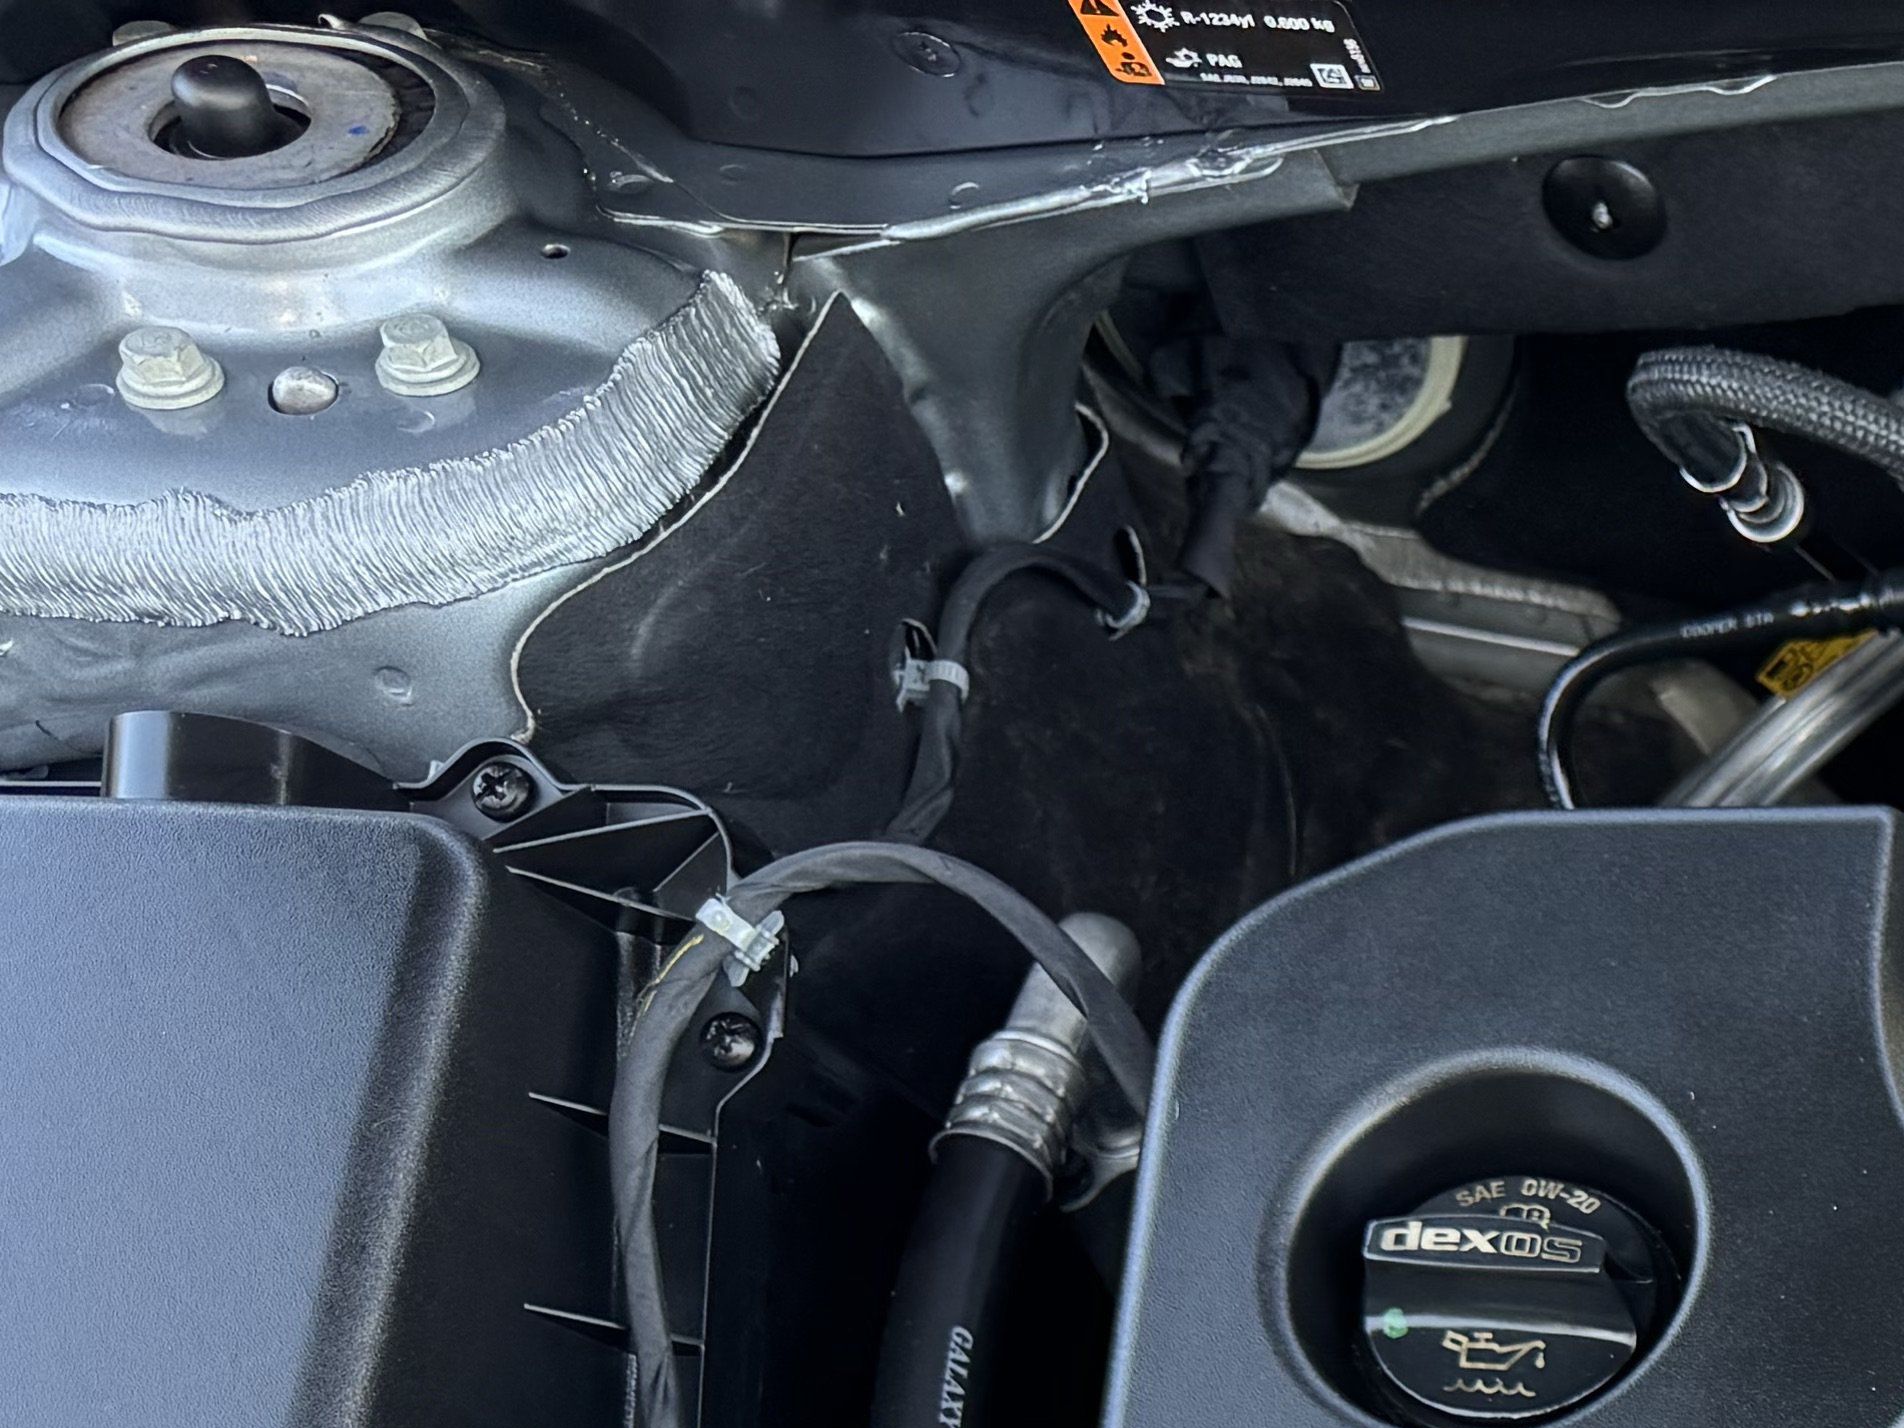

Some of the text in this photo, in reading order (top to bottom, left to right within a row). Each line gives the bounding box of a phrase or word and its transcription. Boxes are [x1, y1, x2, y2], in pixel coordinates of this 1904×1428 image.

[1310, 18, 1335, 33] kg
[1207, 54, 1243, 68] PAG
[1455, 1178, 1602, 1215] SAE 0W-20
[1380, 1221, 1584, 1264] dexos
